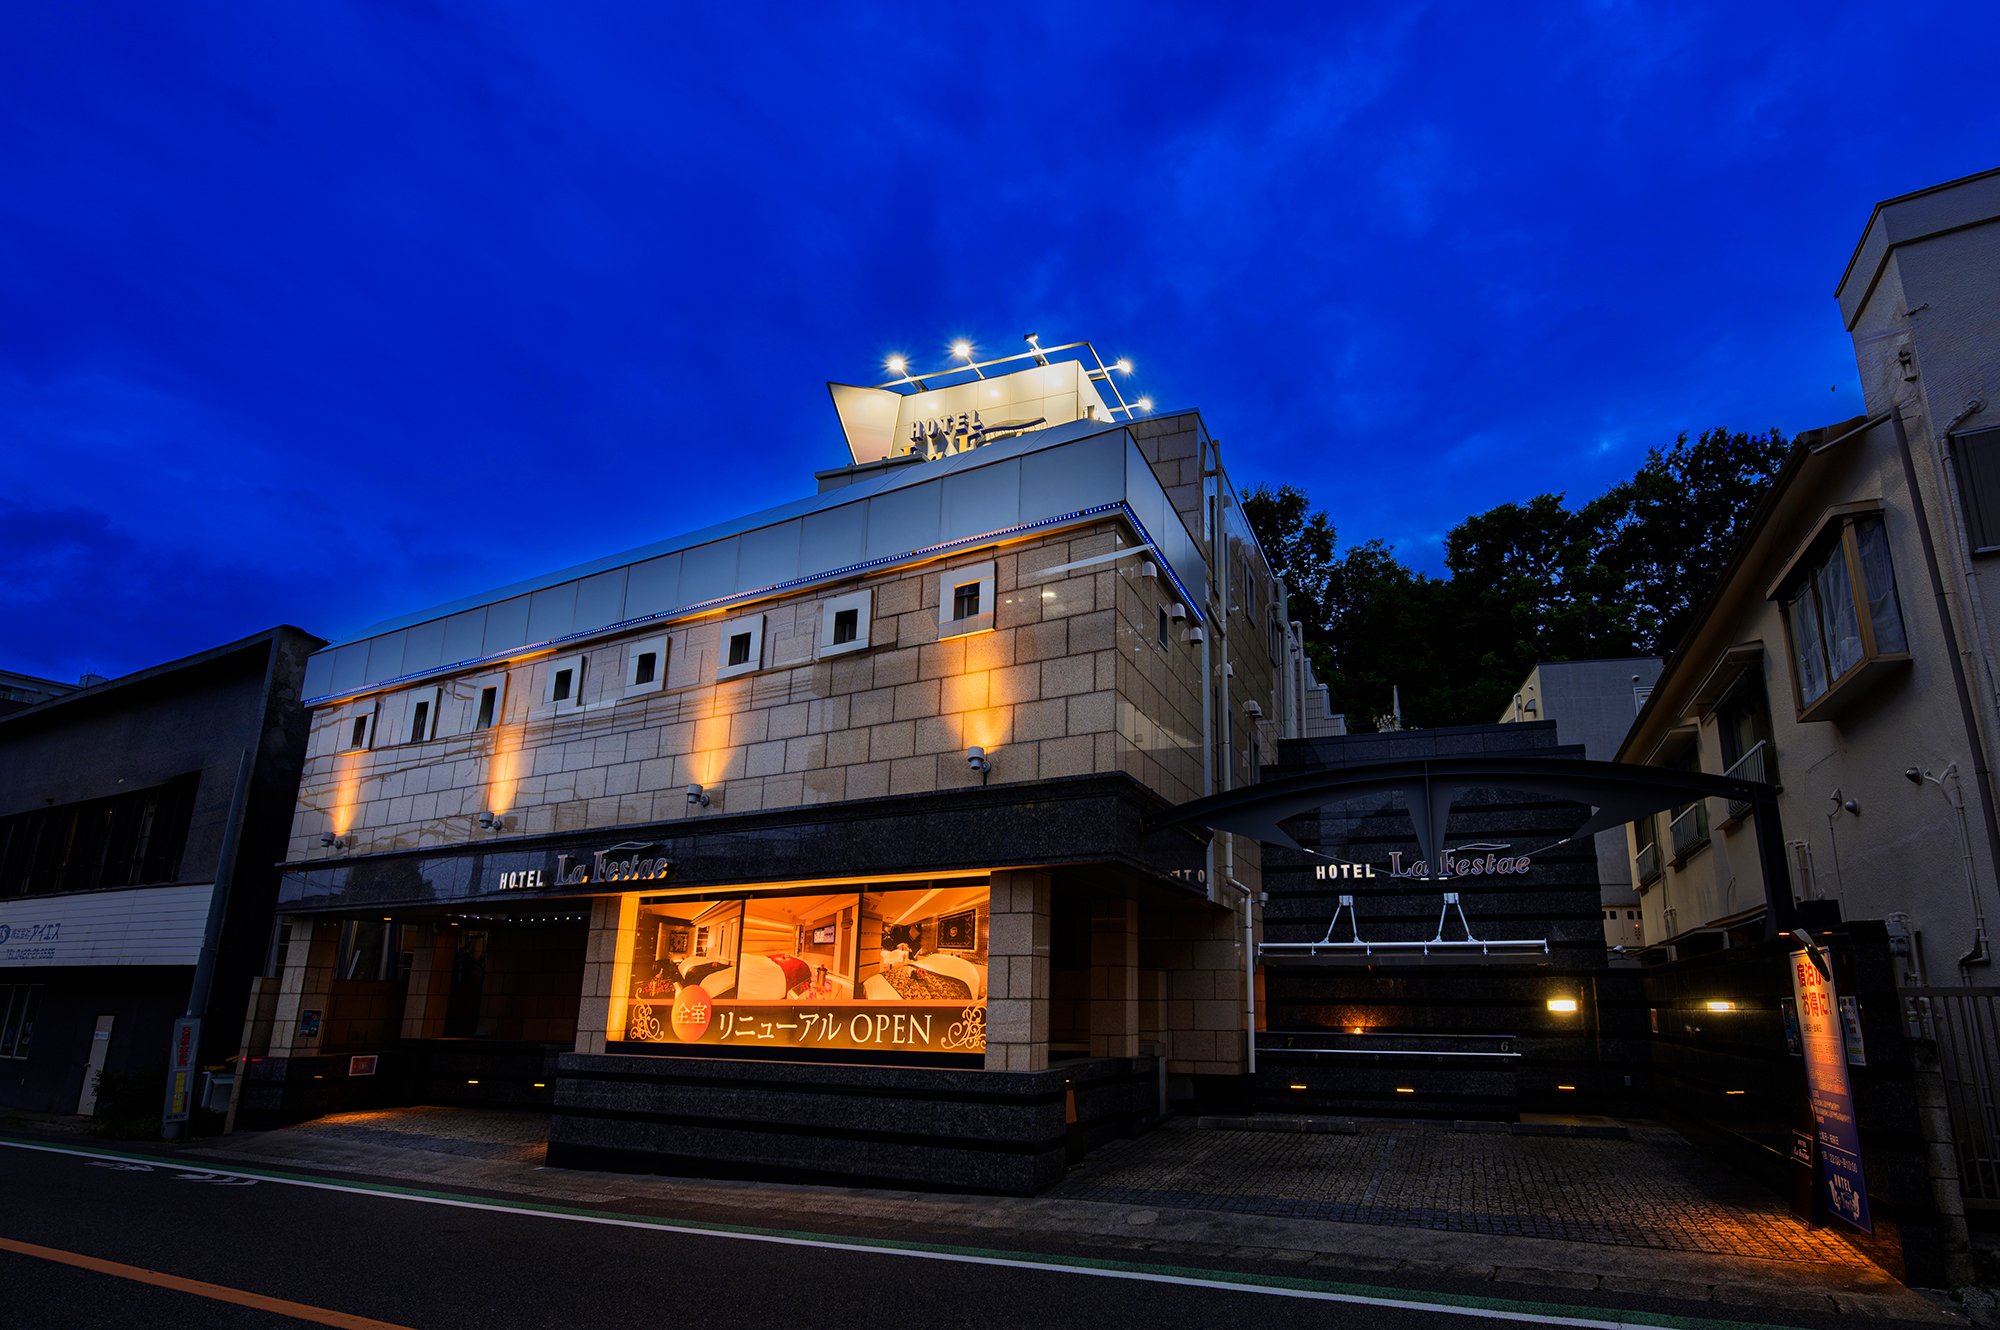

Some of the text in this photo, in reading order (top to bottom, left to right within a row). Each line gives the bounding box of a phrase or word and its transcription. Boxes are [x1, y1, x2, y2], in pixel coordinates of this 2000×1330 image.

[909, 410, 983, 442] HOTEL
[499, 850, 669, 890] HOTEL La Festae
[1316, 848, 1531, 881] HOTEL La Festae
[675, 1001, 708, 1025] 全室
[718, 1011, 933, 1044] リニューアル OPEN
[1287, 1037, 1294, 1048] 7
[1500, 1041, 1509, 1052] 6
[1833, 1173, 1852, 1193] HOTEL
